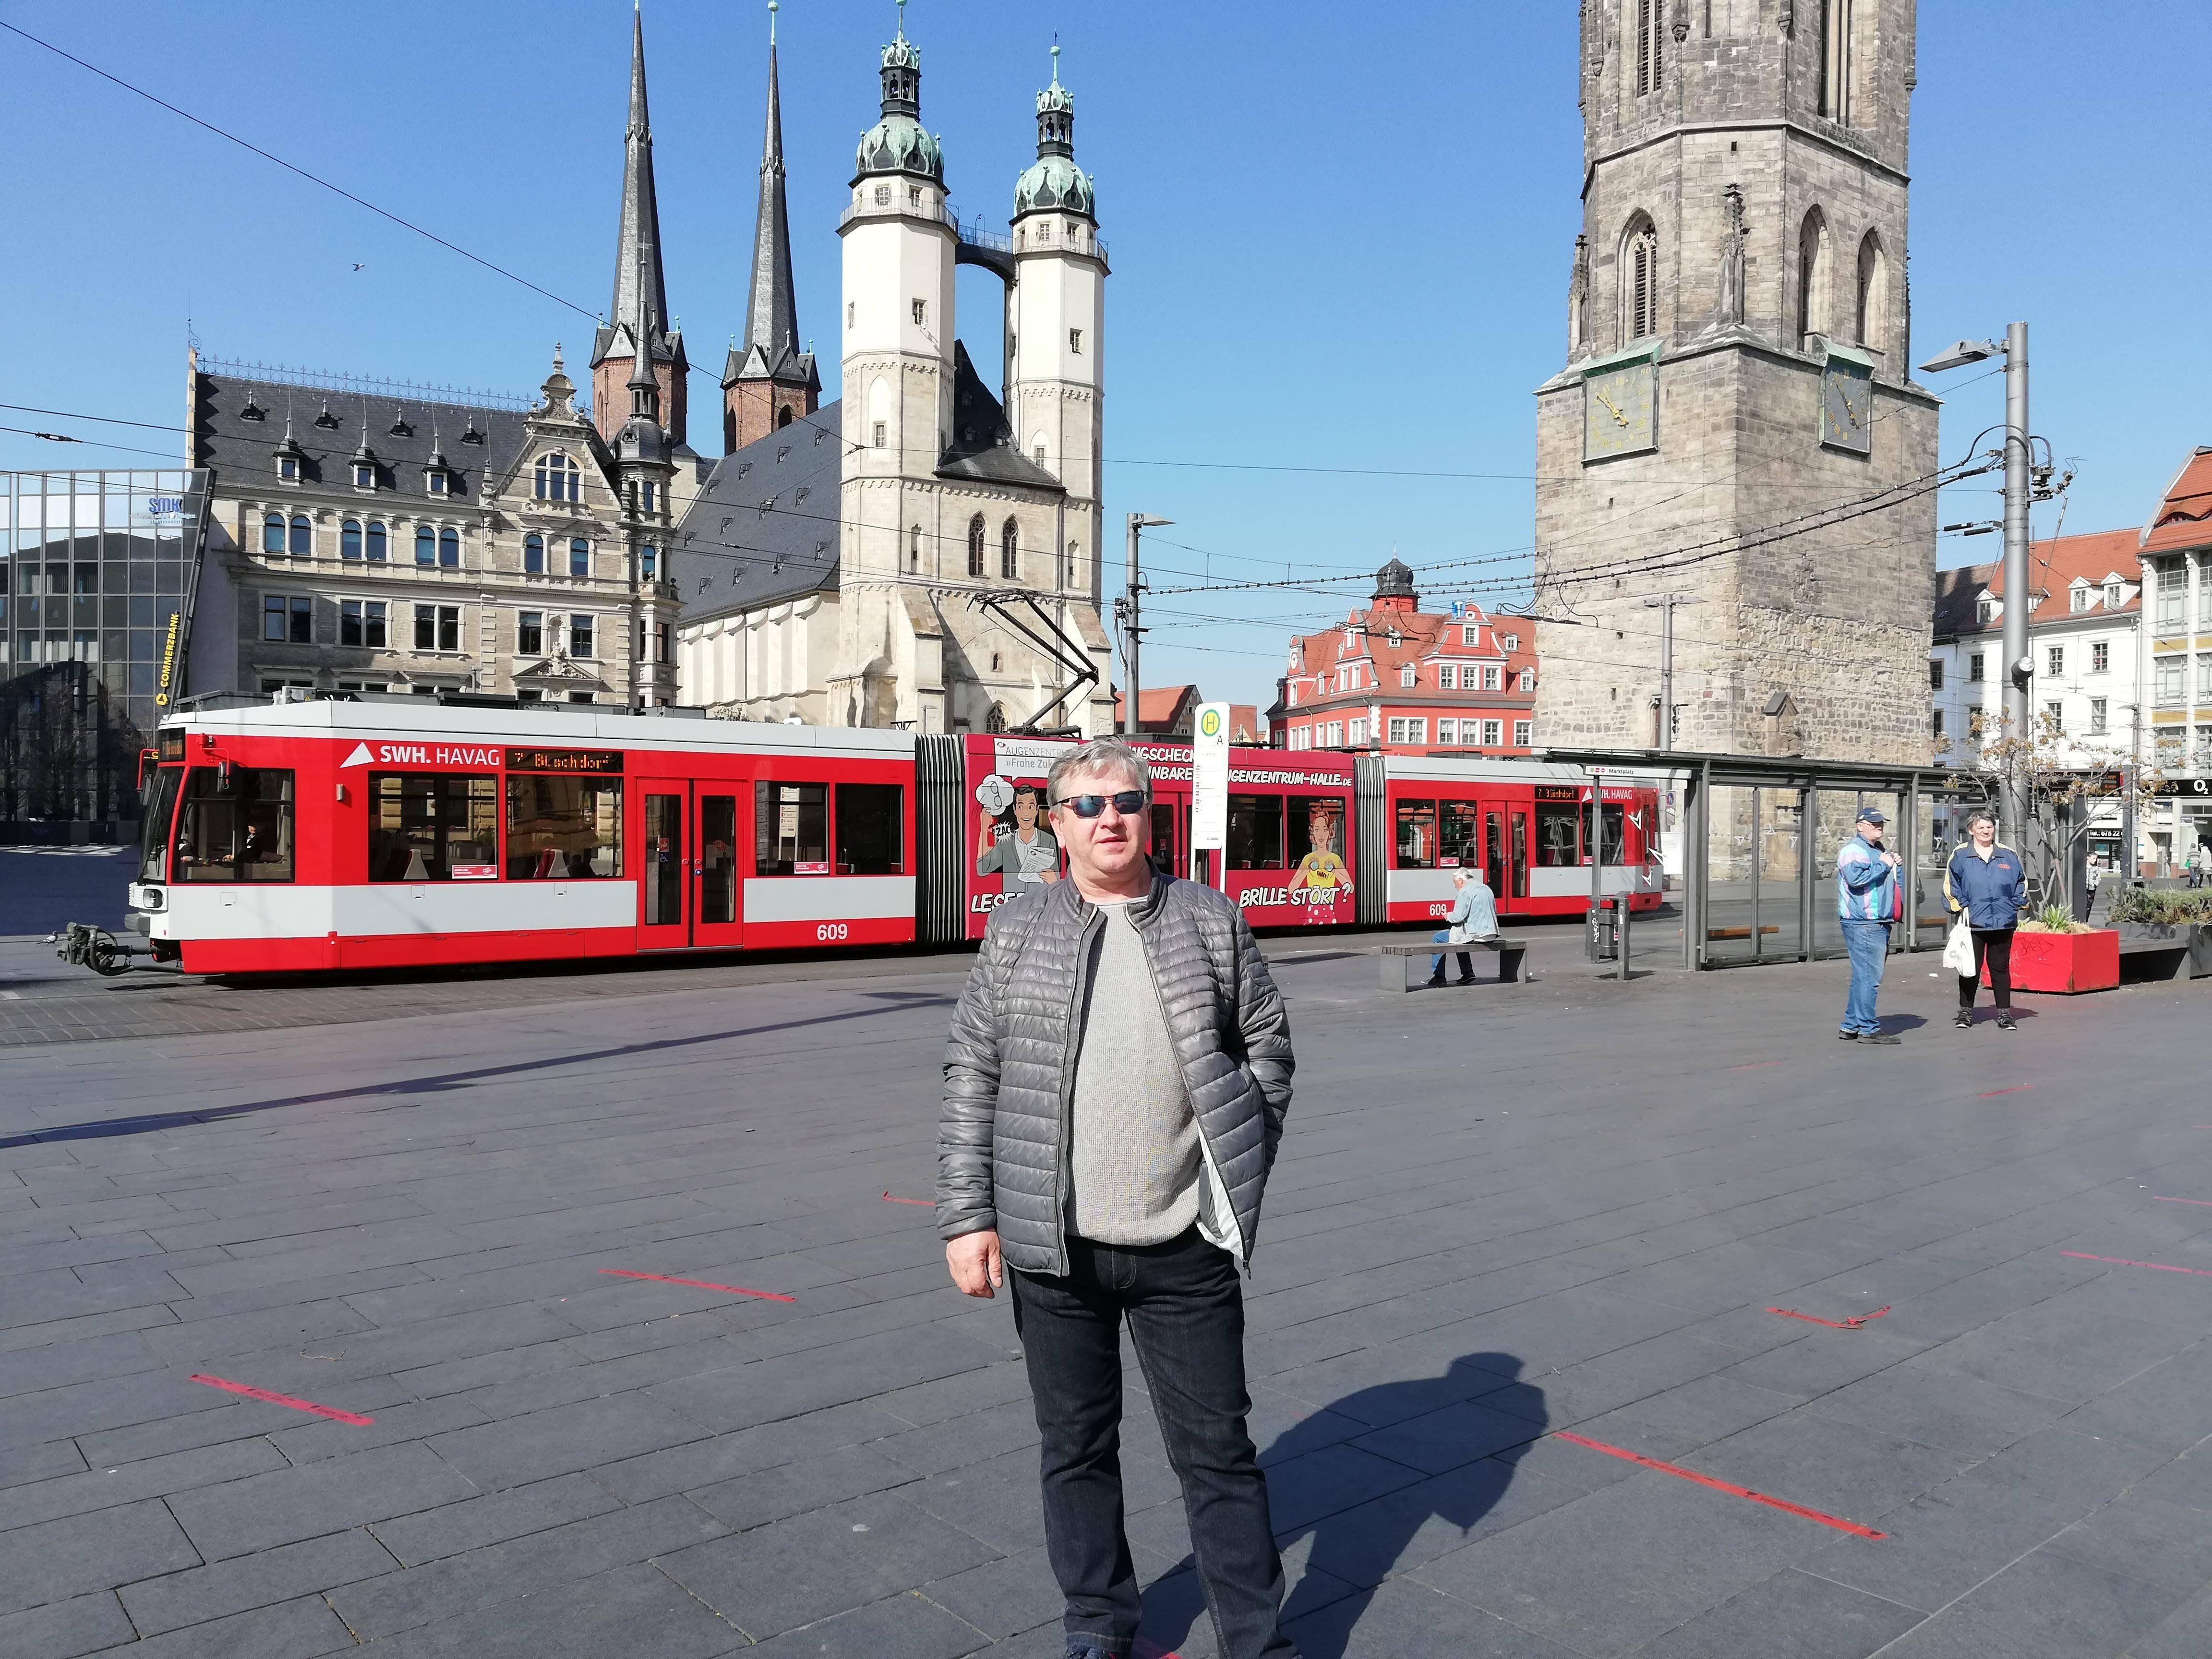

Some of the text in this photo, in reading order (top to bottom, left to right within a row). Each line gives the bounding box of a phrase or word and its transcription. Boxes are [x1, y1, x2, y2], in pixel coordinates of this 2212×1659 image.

[160, 613, 180, 688] COMMERZBANK
[1206, 715, 1215, 731] H
[1216, 735, 1223, 745] A
[380, 745, 500, 766] SWH. HAVAG
[1006, 746, 1067, 757] AUGENZENTR
[1037, 759, 1054, 768] Zuk
[1611, 789, 1633, 800] HAVAG
[1239, 887, 1288, 907] BRILLE
[1290, 885, 1340, 905] STÖRT
[1430, 903, 1447, 916] 609
[817, 923, 848, 941] 609
